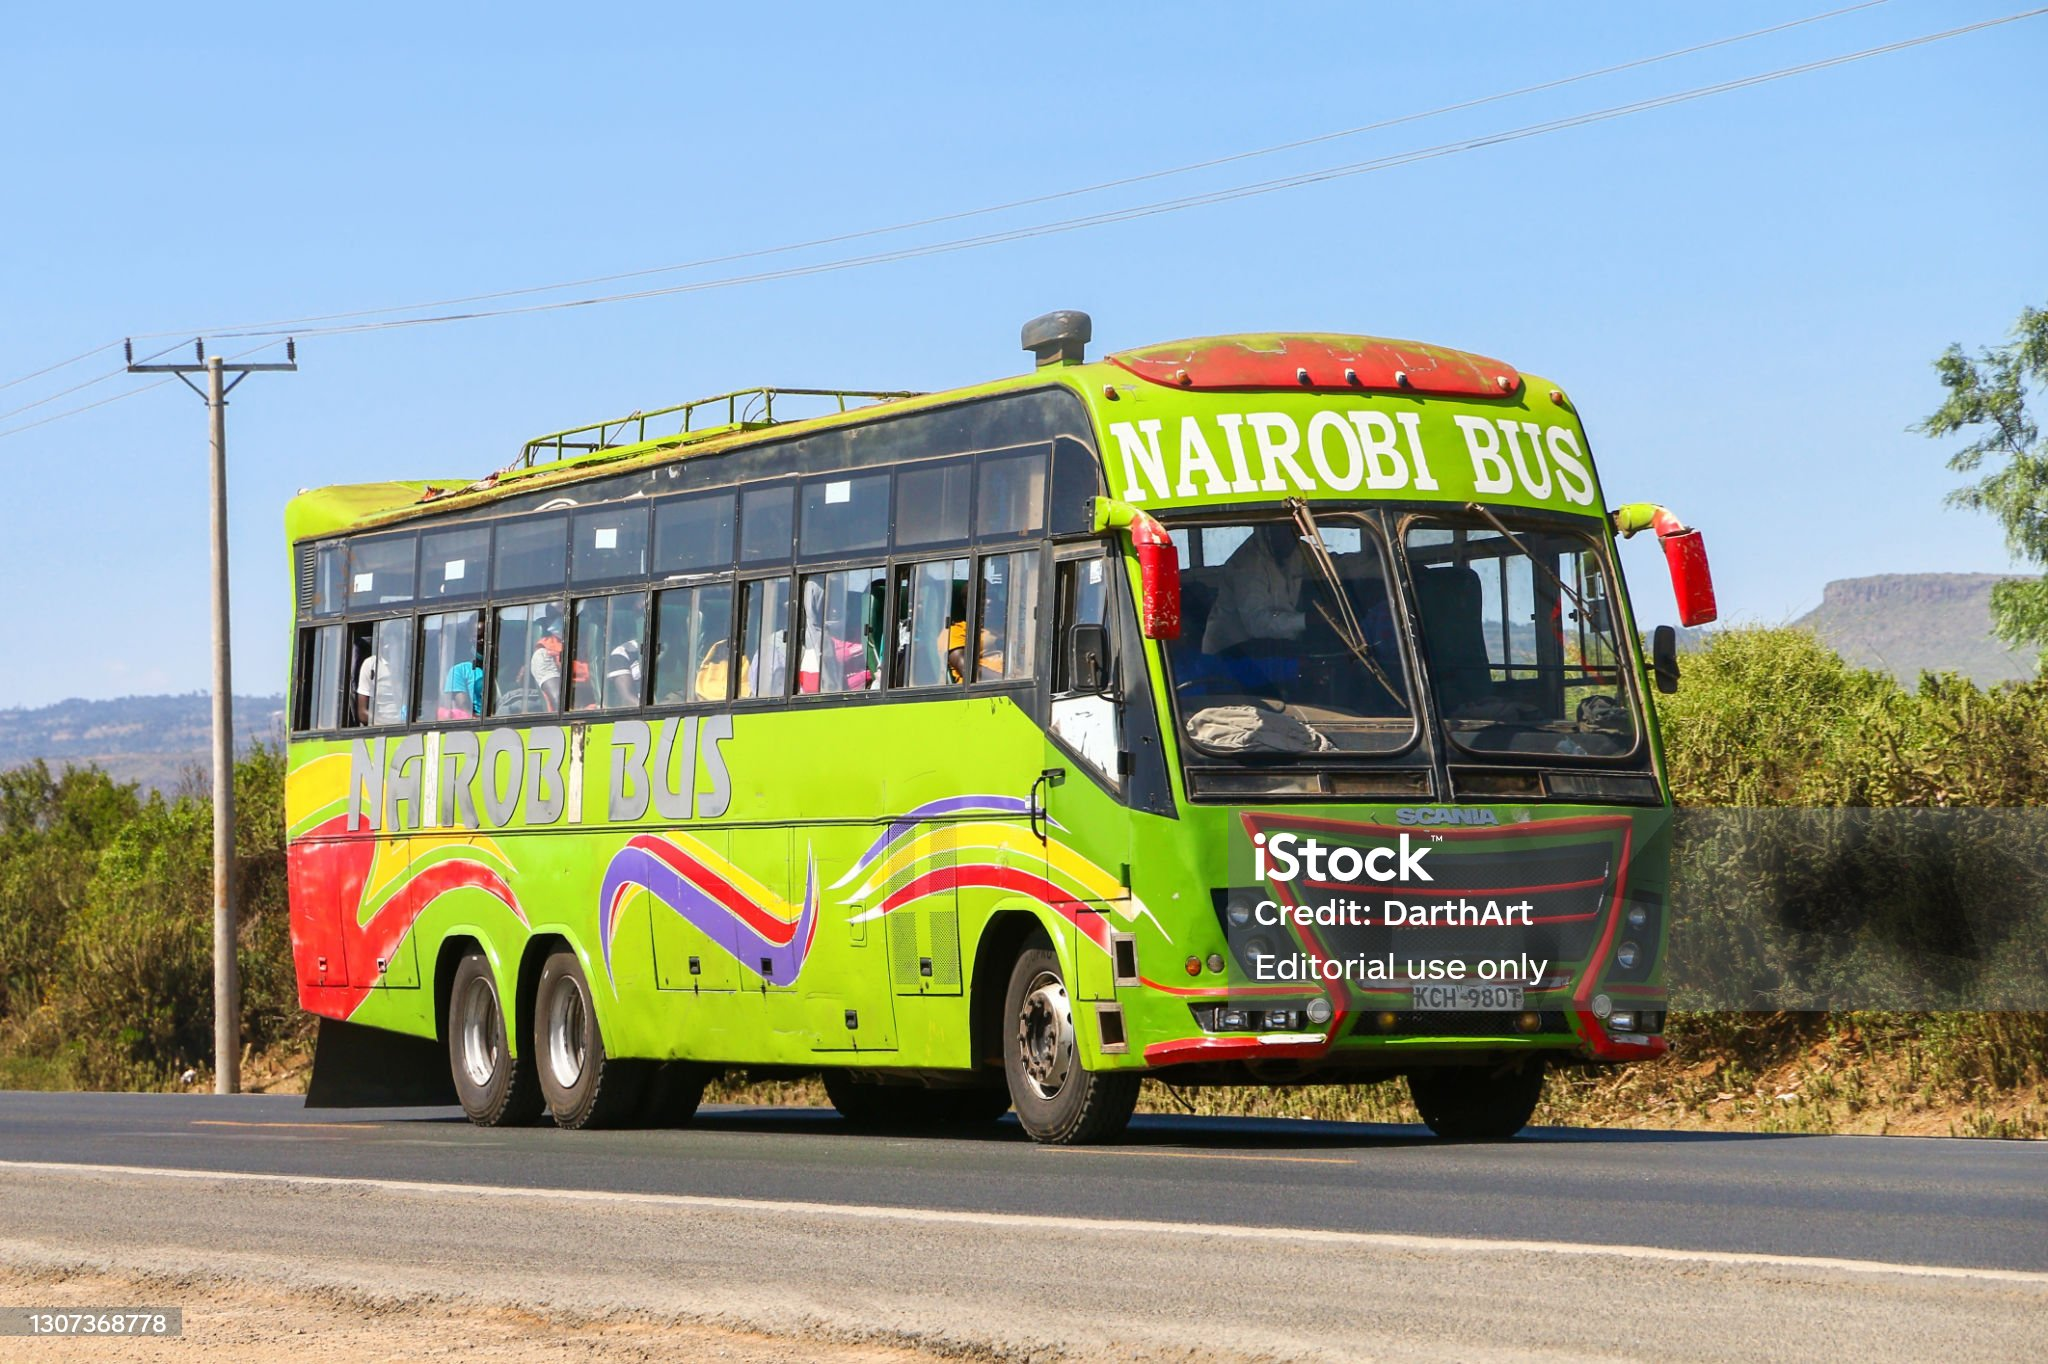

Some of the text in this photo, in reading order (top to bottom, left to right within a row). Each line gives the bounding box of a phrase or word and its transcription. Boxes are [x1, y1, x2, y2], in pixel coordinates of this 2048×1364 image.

[1110, 412, 1596, 508] NAIROBI BUS
[347, 714, 733, 832] NAIROBI BUS
[1396, 807, 1499, 825] SCANIA
